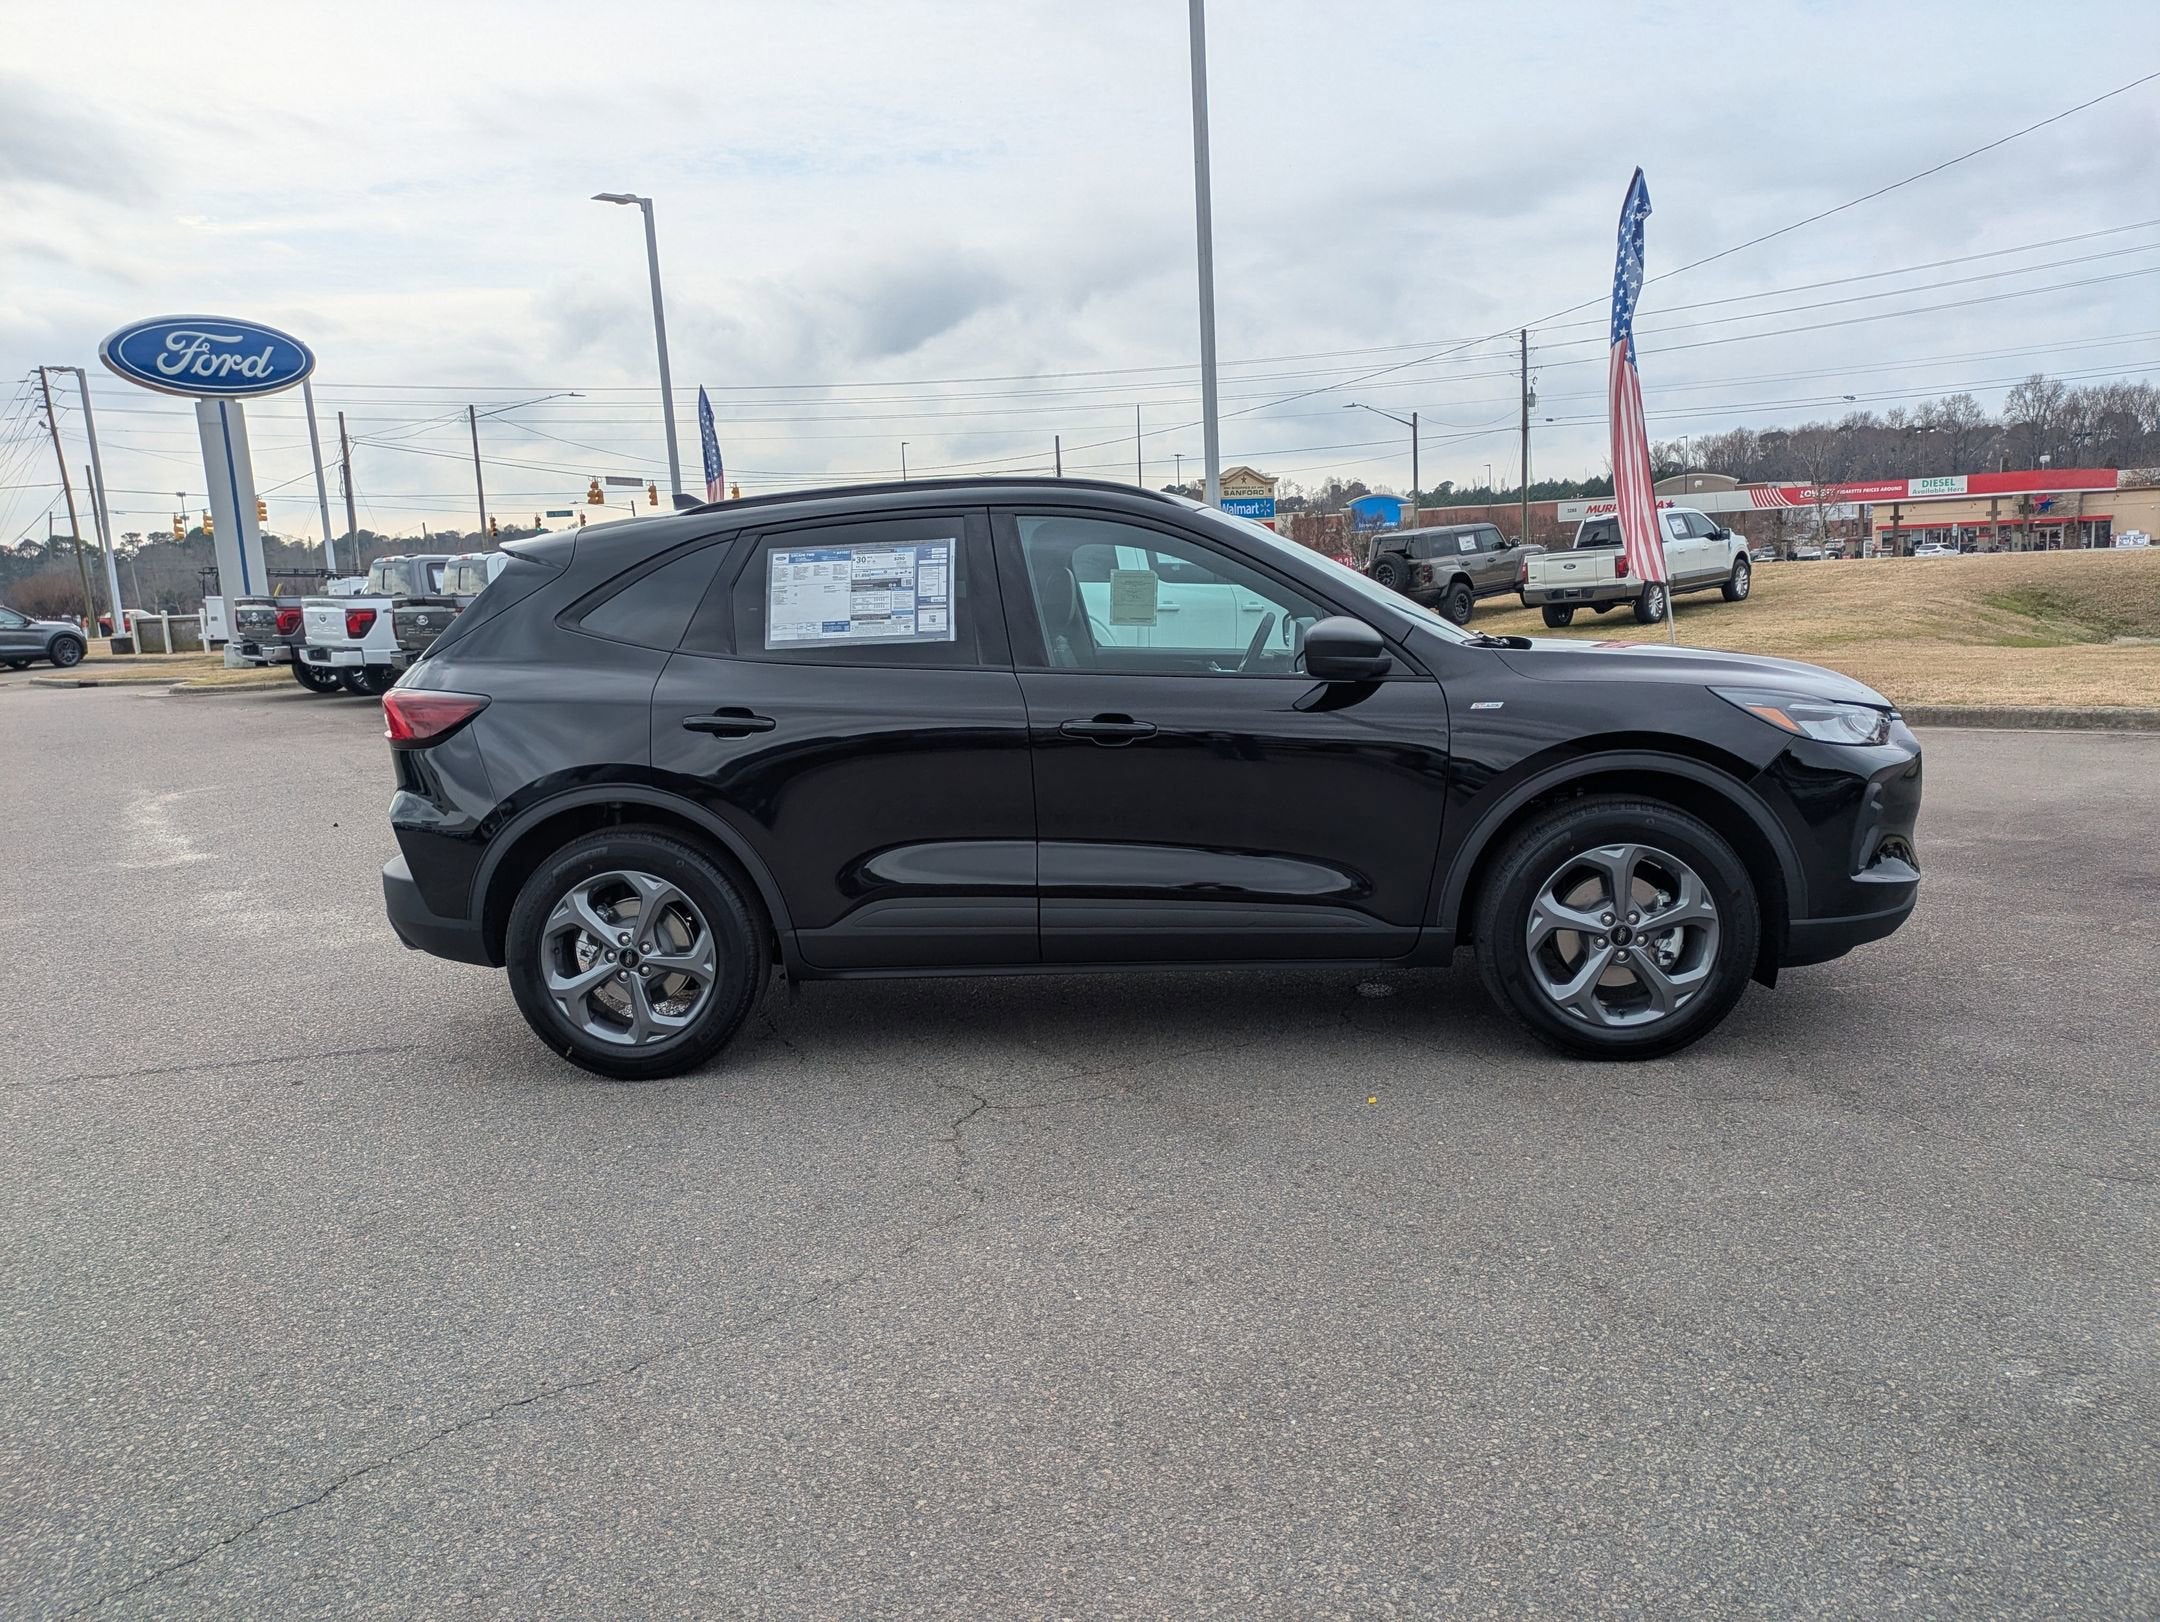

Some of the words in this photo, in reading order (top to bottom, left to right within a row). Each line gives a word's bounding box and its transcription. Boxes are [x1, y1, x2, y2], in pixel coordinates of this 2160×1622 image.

[156, 331, 274, 378] Ford
[1921, 478, 1955, 488] DIESEL
[1223, 489, 1265, 497] SANFORD
[1912, 487, 1945, 495] Available
